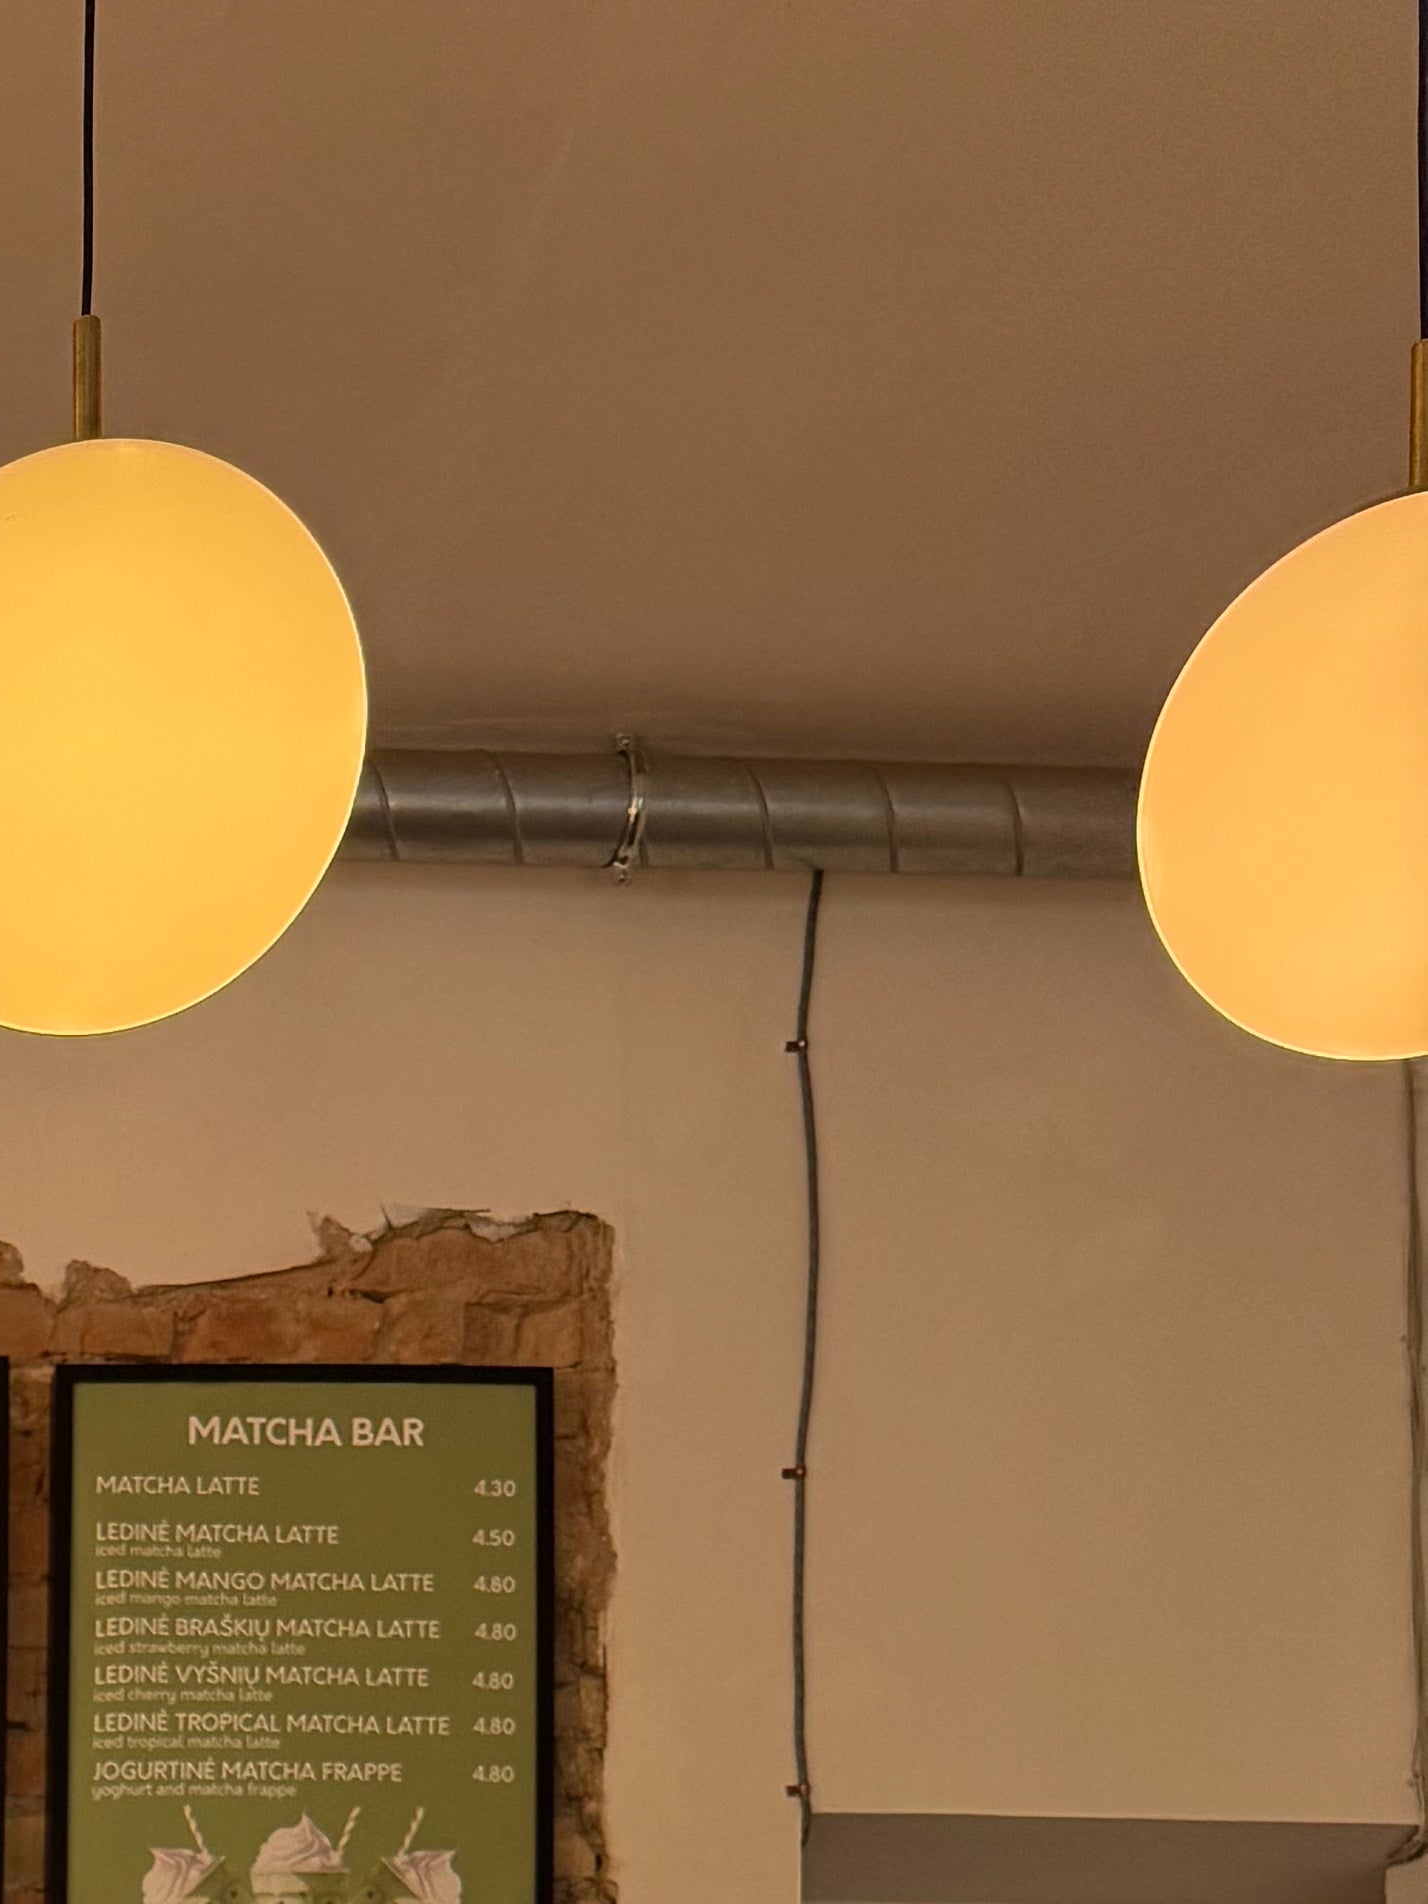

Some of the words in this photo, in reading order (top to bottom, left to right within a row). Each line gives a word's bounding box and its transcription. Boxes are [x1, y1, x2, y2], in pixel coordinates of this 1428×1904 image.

[189, 1416, 342, 1446] MATCHA
[353, 1418, 423, 1446] BAR
[96, 1476, 190, 1494] MATCHA
[197, 1477, 259, 1495] LATTE
[474, 1479, 516, 1497] 4.30
[97, 1520, 169, 1542] LEDINĖ
[176, 1524, 269, 1543] MATCHA
[276, 1525, 338, 1544] LATTE
[473, 1529, 515, 1546] 4.50
[96, 1567, 169, 1590] LEDINĖ
[176, 1572, 265, 1591] MANGO
[271, 1573, 365, 1591] MATCHA
[371, 1573, 434, 1591] LATTE
[474, 1576, 515, 1593] 4.80
[96, 1614, 169, 1637] LEDINĖ
[174, 1613, 268, 1641] BRAŠKIŲ
[277, 1619, 370, 1637] MATCHA
[377, 1620, 439, 1638] LATTE
[475, 1623, 516, 1641] 4.80
[95, 1661, 168, 1685] LEDINĖ
[174, 1661, 261, 1689] VYŠNIŲ
[266, 1666, 359, 1685] MATCHA
[366, 1668, 428, 1687] LATTE
[94, 1709, 168, 1732] LEDINĖ
[175, 1713, 280, 1732] TROPICAL
[287, 1715, 380, 1734] MATCHA
[387, 1716, 449, 1735] LATTE
[473, 1717, 515, 1734] 4.80
[94, 1757, 215, 1780] JOGURTINĖ
[222, 1761, 316, 1780] MATCHA
[322, 1762, 401, 1782] FRAPPE
[472, 1765, 515, 1783] 4.80
